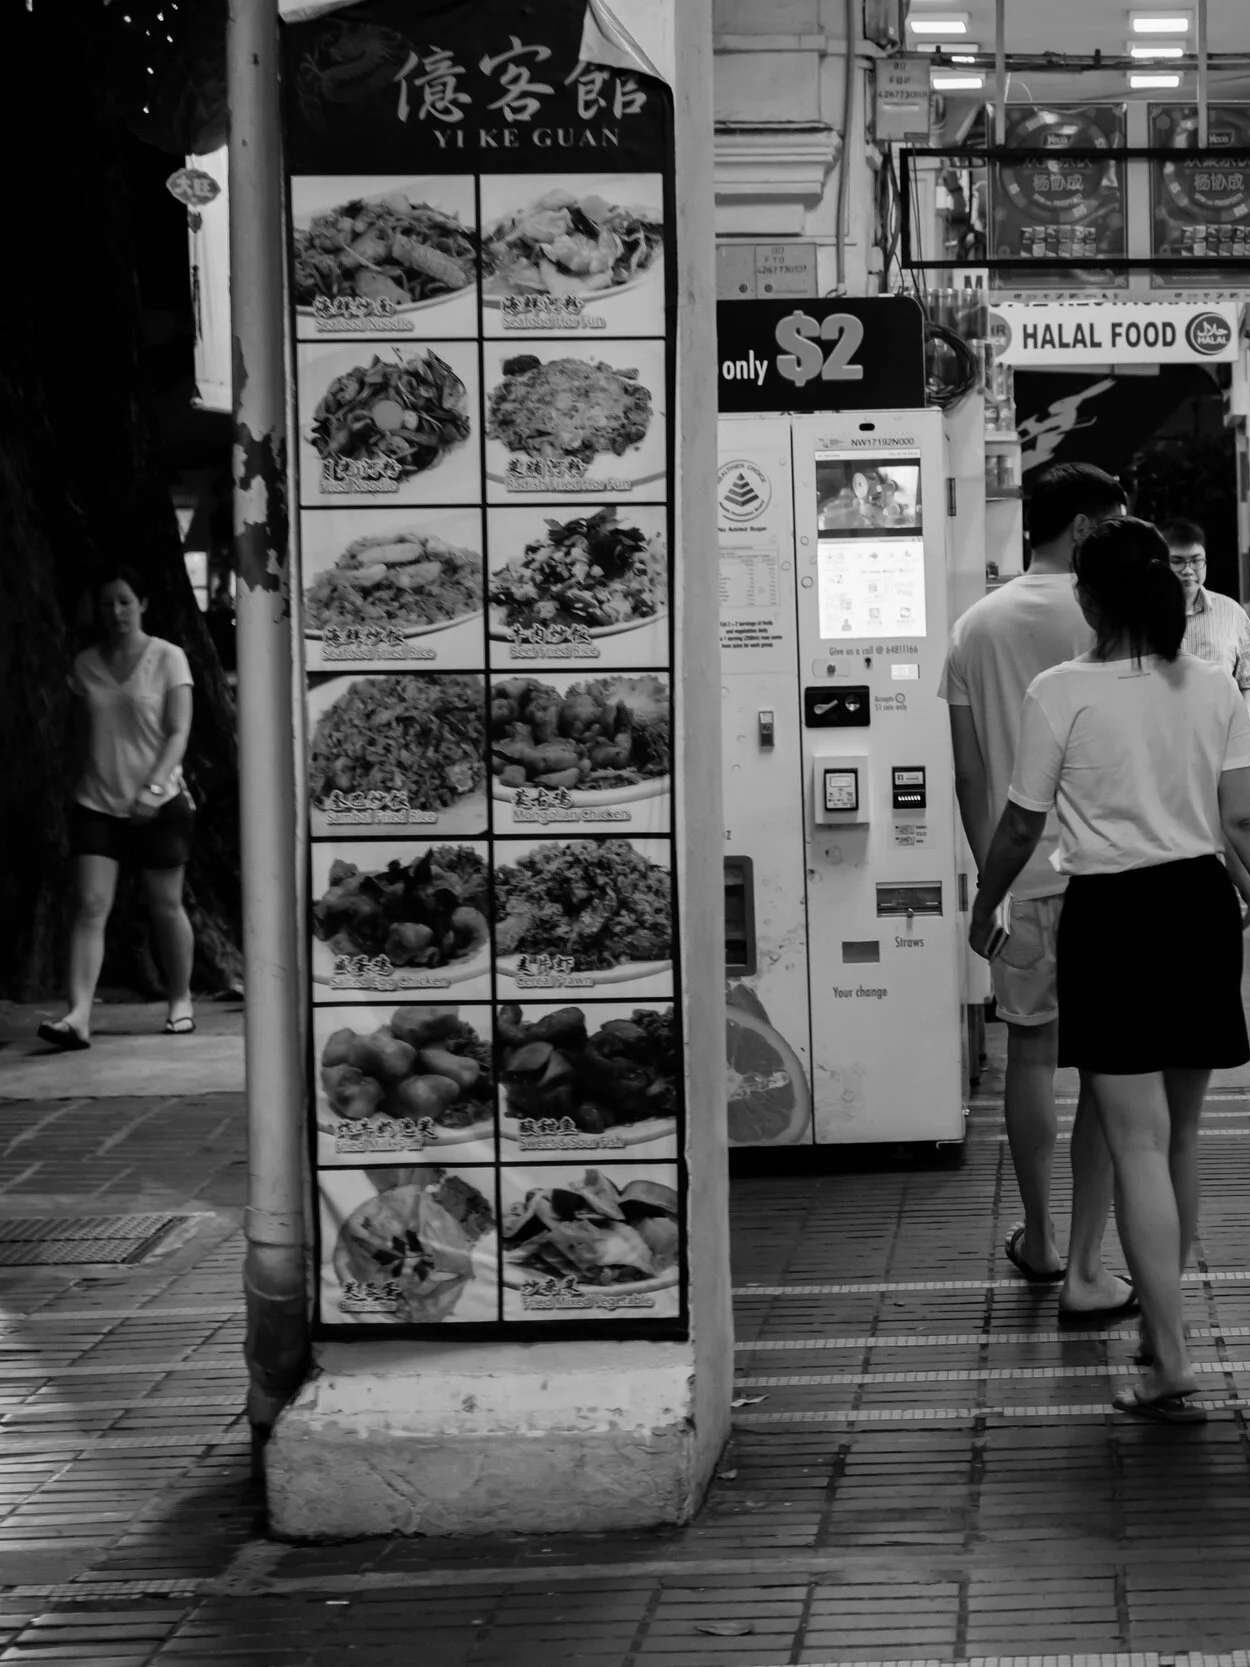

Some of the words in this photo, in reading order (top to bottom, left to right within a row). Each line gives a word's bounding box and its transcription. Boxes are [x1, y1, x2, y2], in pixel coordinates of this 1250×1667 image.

[433, 129, 464, 148] YI
[480, 129, 519, 147] KE
[532, 128, 621, 148] GUAN
[1022, 322, 1102, 349] HALAL
[1111, 321, 1177, 348] FOOD
[1197, 336, 1228, 345] HALAL
[722, 349, 768, 386] only
[775, 310, 864, 388] $2
[512, 809, 580, 824] Mongolian
[580, 808, 631, 822] Chicken
[894, 936, 924, 948] Straws
[399, 975, 450, 989] Chicken
[832, 986, 853, 999] Your
[855, 984, 888, 1000] change
[519, 1137, 558, 1150] Sweet
[569, 1136, 598, 1149] Sour
[600, 1136, 625, 1149] Fish
